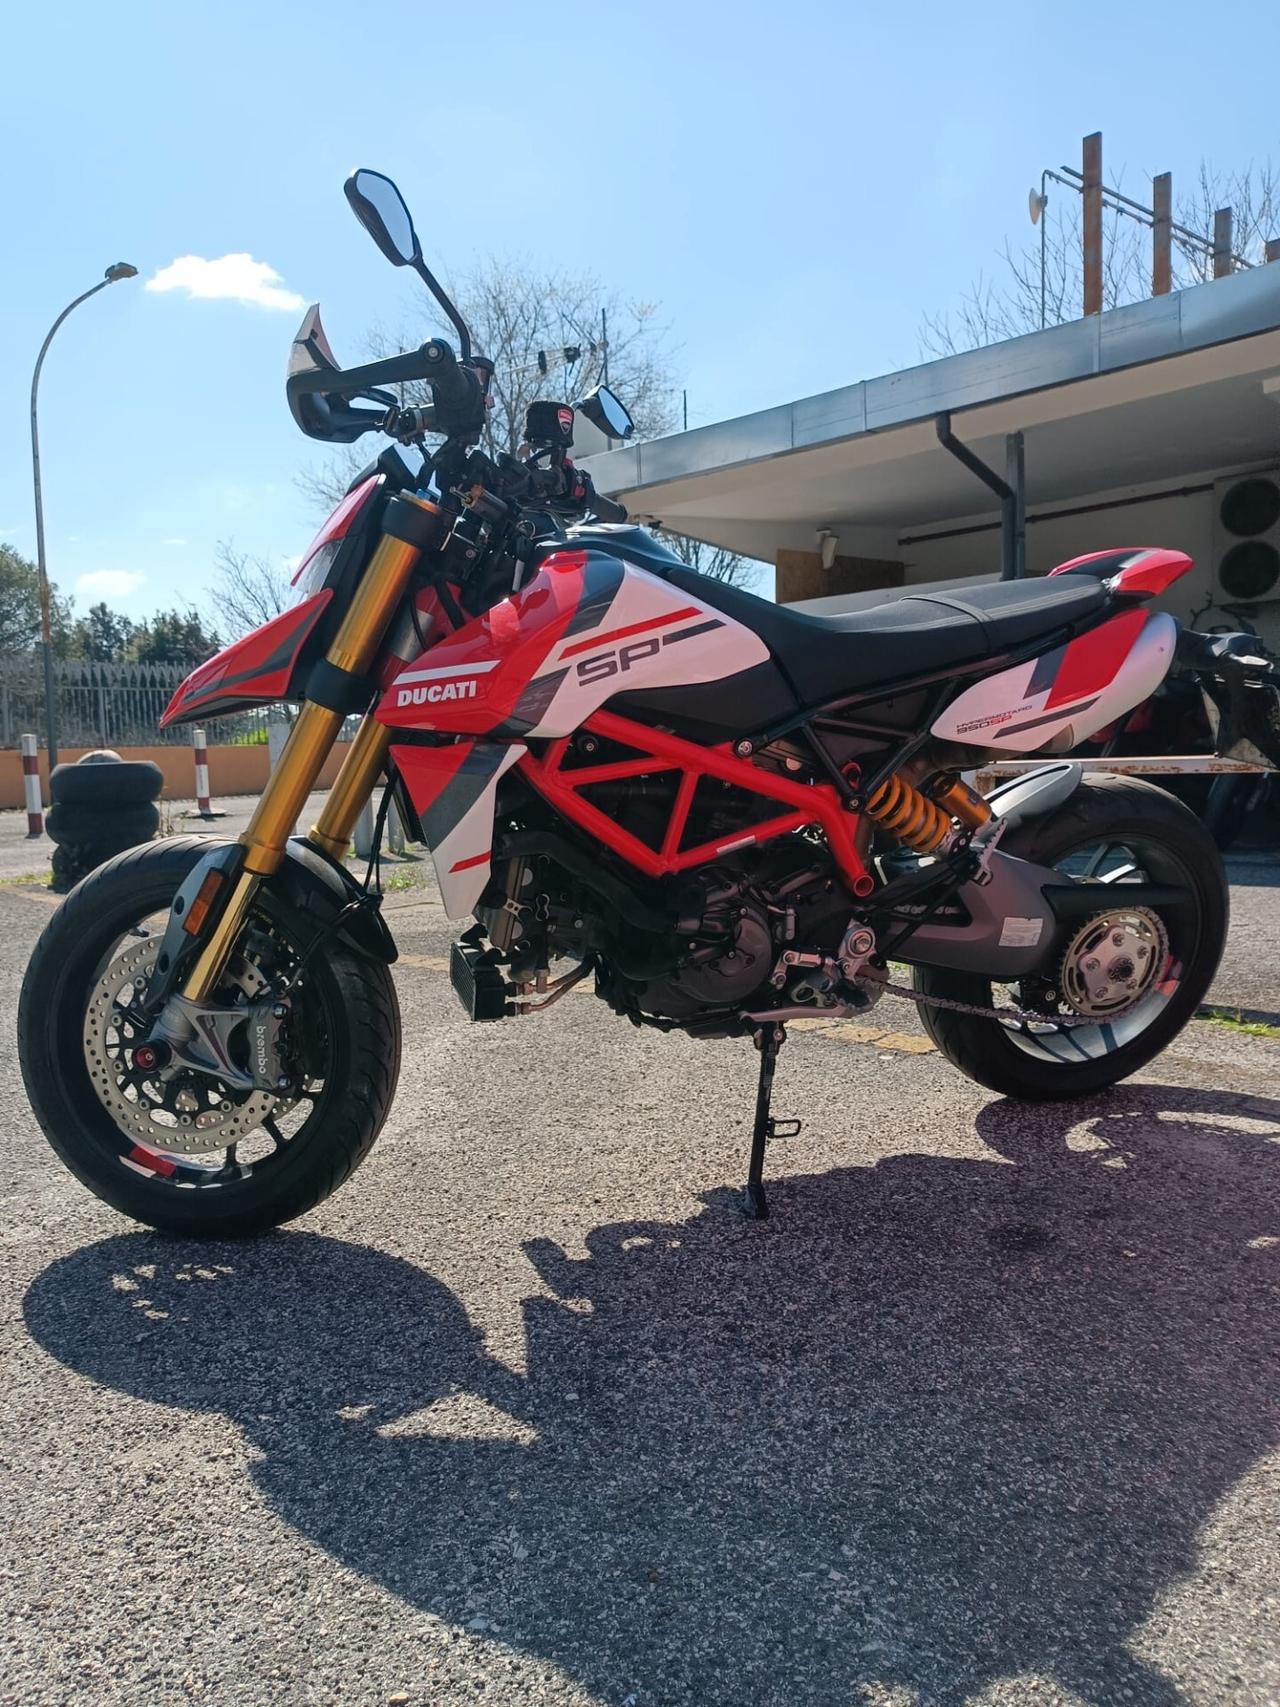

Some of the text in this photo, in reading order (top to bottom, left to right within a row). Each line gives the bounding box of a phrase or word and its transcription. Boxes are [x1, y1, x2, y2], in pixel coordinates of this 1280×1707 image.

[576, 637, 660, 687] SP
[397, 680, 477, 707] DUCATI
[256, 1025, 268, 1074] brembo
